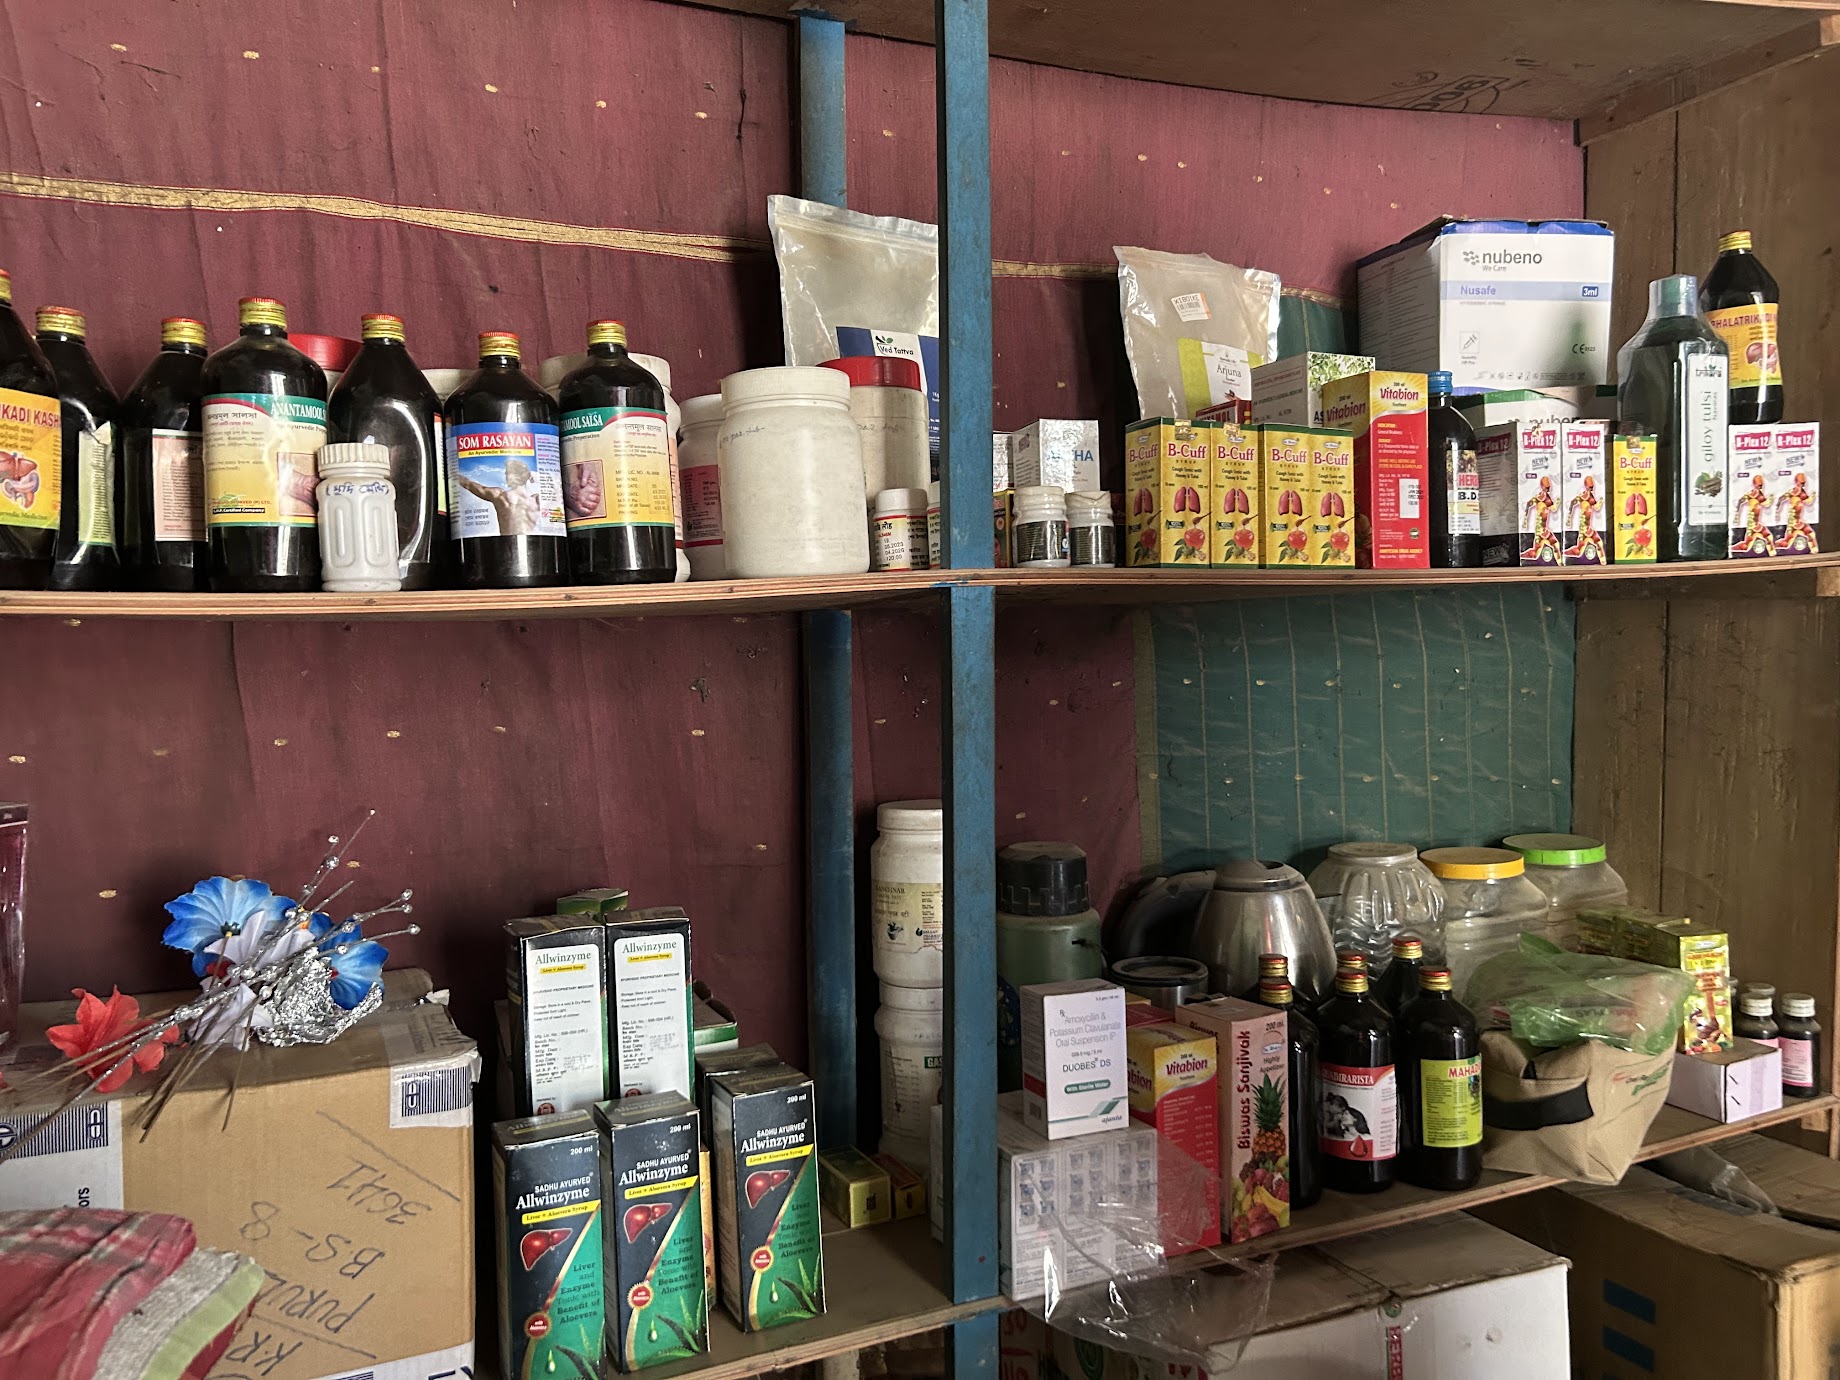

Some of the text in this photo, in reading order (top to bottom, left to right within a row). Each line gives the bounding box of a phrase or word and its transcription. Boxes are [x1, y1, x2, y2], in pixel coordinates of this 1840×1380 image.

[1482, 249, 1542, 264] nubeno
[1460, 285, 1497, 295] Nusafe
[1583, 287, 1597, 297] 3ml
[880, 345, 893, 354] Ved
[1216, 364, 1242, 380] Arjuna
[1379, 387, 1419, 401] Vitabion
[1326, 401, 1366, 422] Vitabion
[1700, 391, 1712, 421] tulsi
[0, 404, 30, 424] KADI
[581, 414, 604, 428] SALSA
[458, 435, 531, 449] SOM RASAYAN
[1545, 434, 1555, 447] 12
[1589, 434, 1599, 447] 12
[1701, 427, 1714, 462] giloy
[1760, 436, 1769, 446] 12
[1802, 435, 1812, 445] 12
[1129, 444, 1158, 462] B-Cuff
[1168, 443, 1207, 458] B-Cuff
[1217, 446, 1254, 460] B-Cuff
[1271, 448, 1308, 463] B-Cuff
[1313, 451, 1349, 466] B-Cuff
[1619, 457, 1652, 469] B-Cuff
[621, 940, 677, 953] Allwinzyme
[535, 951, 592, 965] Allwinzyme
[1064, 1012, 1107, 1024] Amoxycillin &
[1049, 1022, 1122, 1037] Potassium Clavulanate
[1265, 1021, 1276, 1031] 200
[1055, 1038, 1070, 1048] Oral
[1070, 1033, 1108, 1047] Suspension
[1062, 1058, 1112, 1073] DUOBES DS
[1166, 1057, 1209, 1075] Vitabion
[1236, 1030, 1253, 1093] Sanjivak
[786, 1096, 798, 1104] 200
[669, 1125, 681, 1133] 200
[756, 1121, 806, 1138] SADHU AYURVED
[1237, 1097, 1251, 1150] Biswas
[740, 1132, 805, 1153] Allwinzyme
[636, 1152, 690, 1169] SADHU AYURVED
[618, 1163, 689, 1186] Allwinzyme
[326, 1156, 432, 1225] 3641
[534, 1176, 591, 1193] SADHU AYURVED
[671, 1181, 687, 1189] Syrup
[515, 1188, 590, 1210] Allwinzyme
[526, 1205, 588, 1221] Liver Aloevera Syrup
[239, 1200, 280, 1241] 8
[673, 1236, 693, 1245] Liver
[778, 1239, 806, 1250] Benefit
[781, 1246, 814, 1258] Aloevera
[573, 1262, 596, 1272] Liver
[661, 1254, 694, 1266] Enzyme
[658, 1274, 689, 1286] Benefit
[560, 1281, 595, 1294] Enzyme
[661, 1281, 697, 1295] Aloevera
[557, 1298, 600, 1315] Benefit of
[560, 1311, 598, 1324] Aloevera
